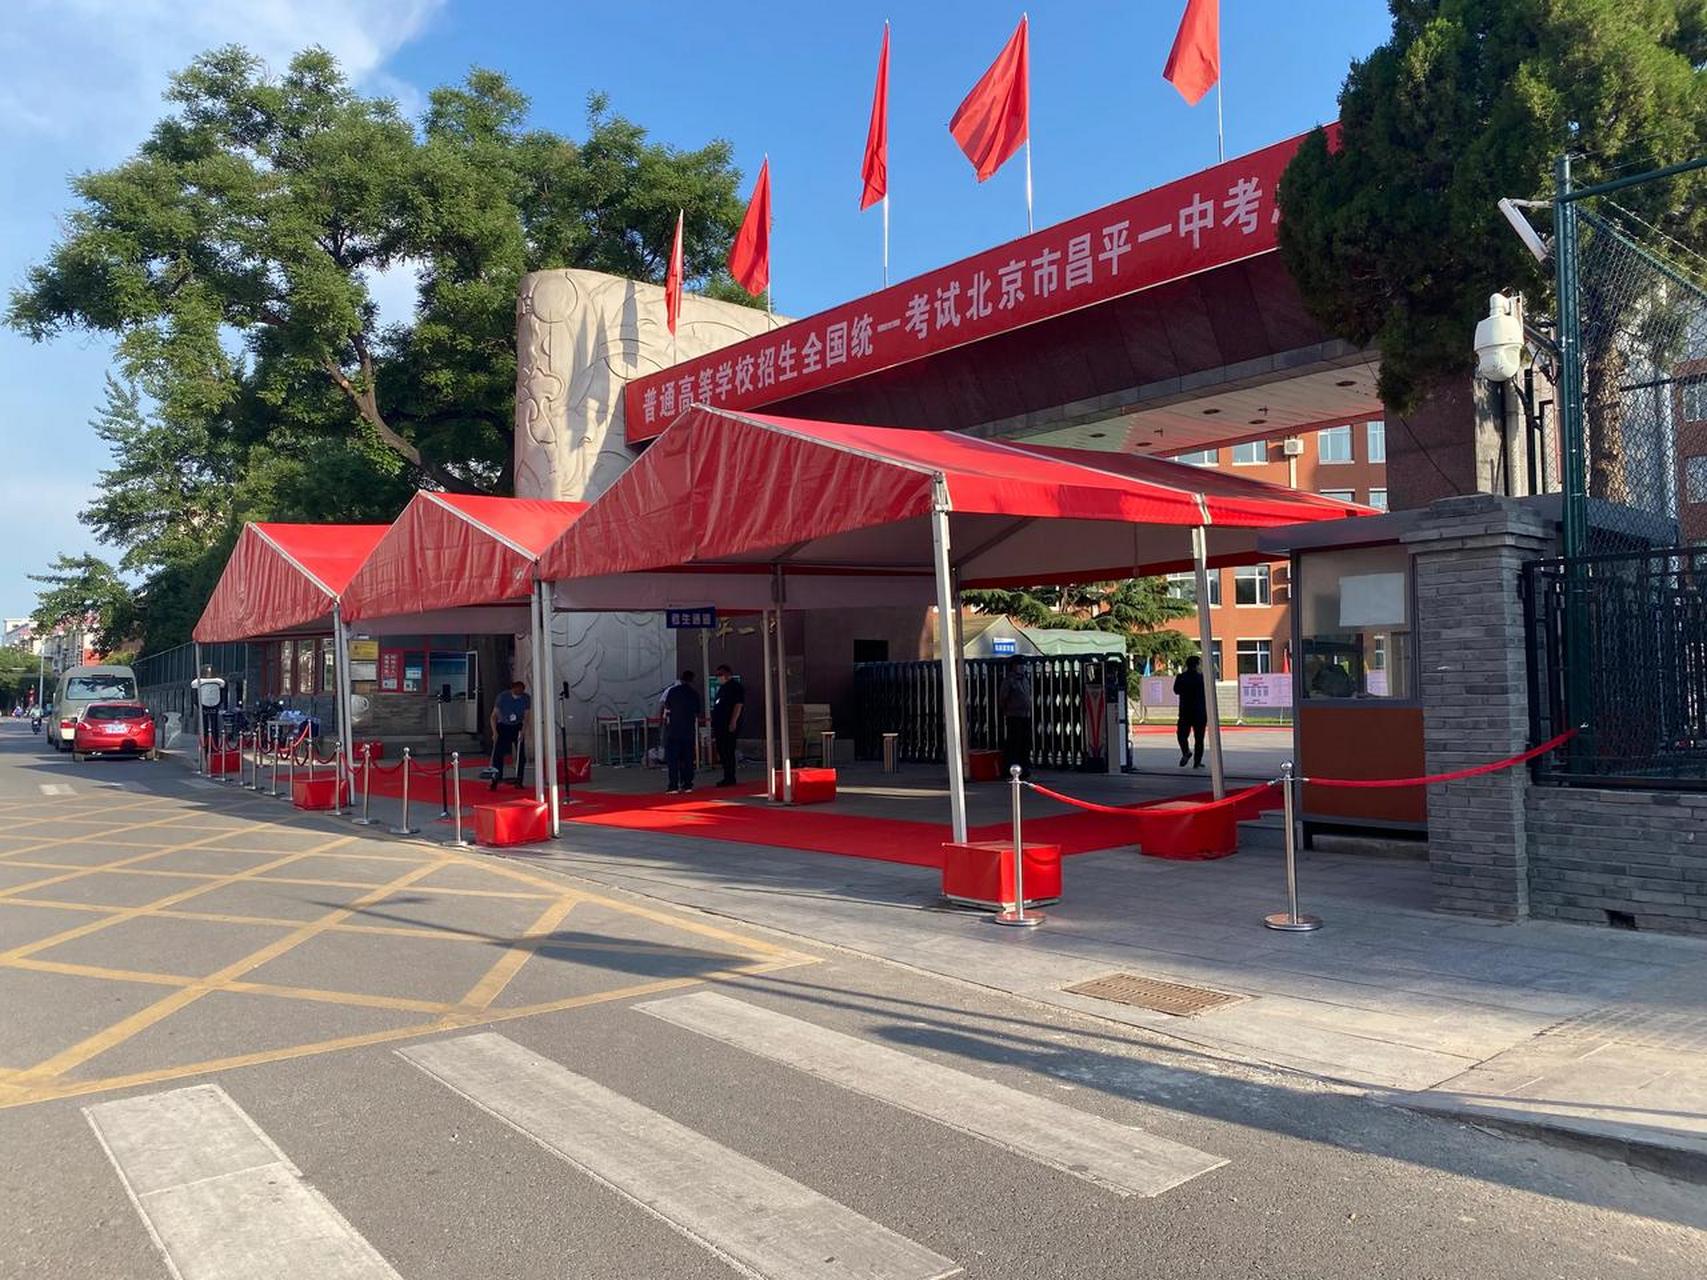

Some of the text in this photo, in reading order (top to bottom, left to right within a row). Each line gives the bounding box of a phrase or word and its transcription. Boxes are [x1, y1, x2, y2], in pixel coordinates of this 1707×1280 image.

[642, 177, 1280, 423] 普通高等学校招生全国统一考试北京市昌平一中考
